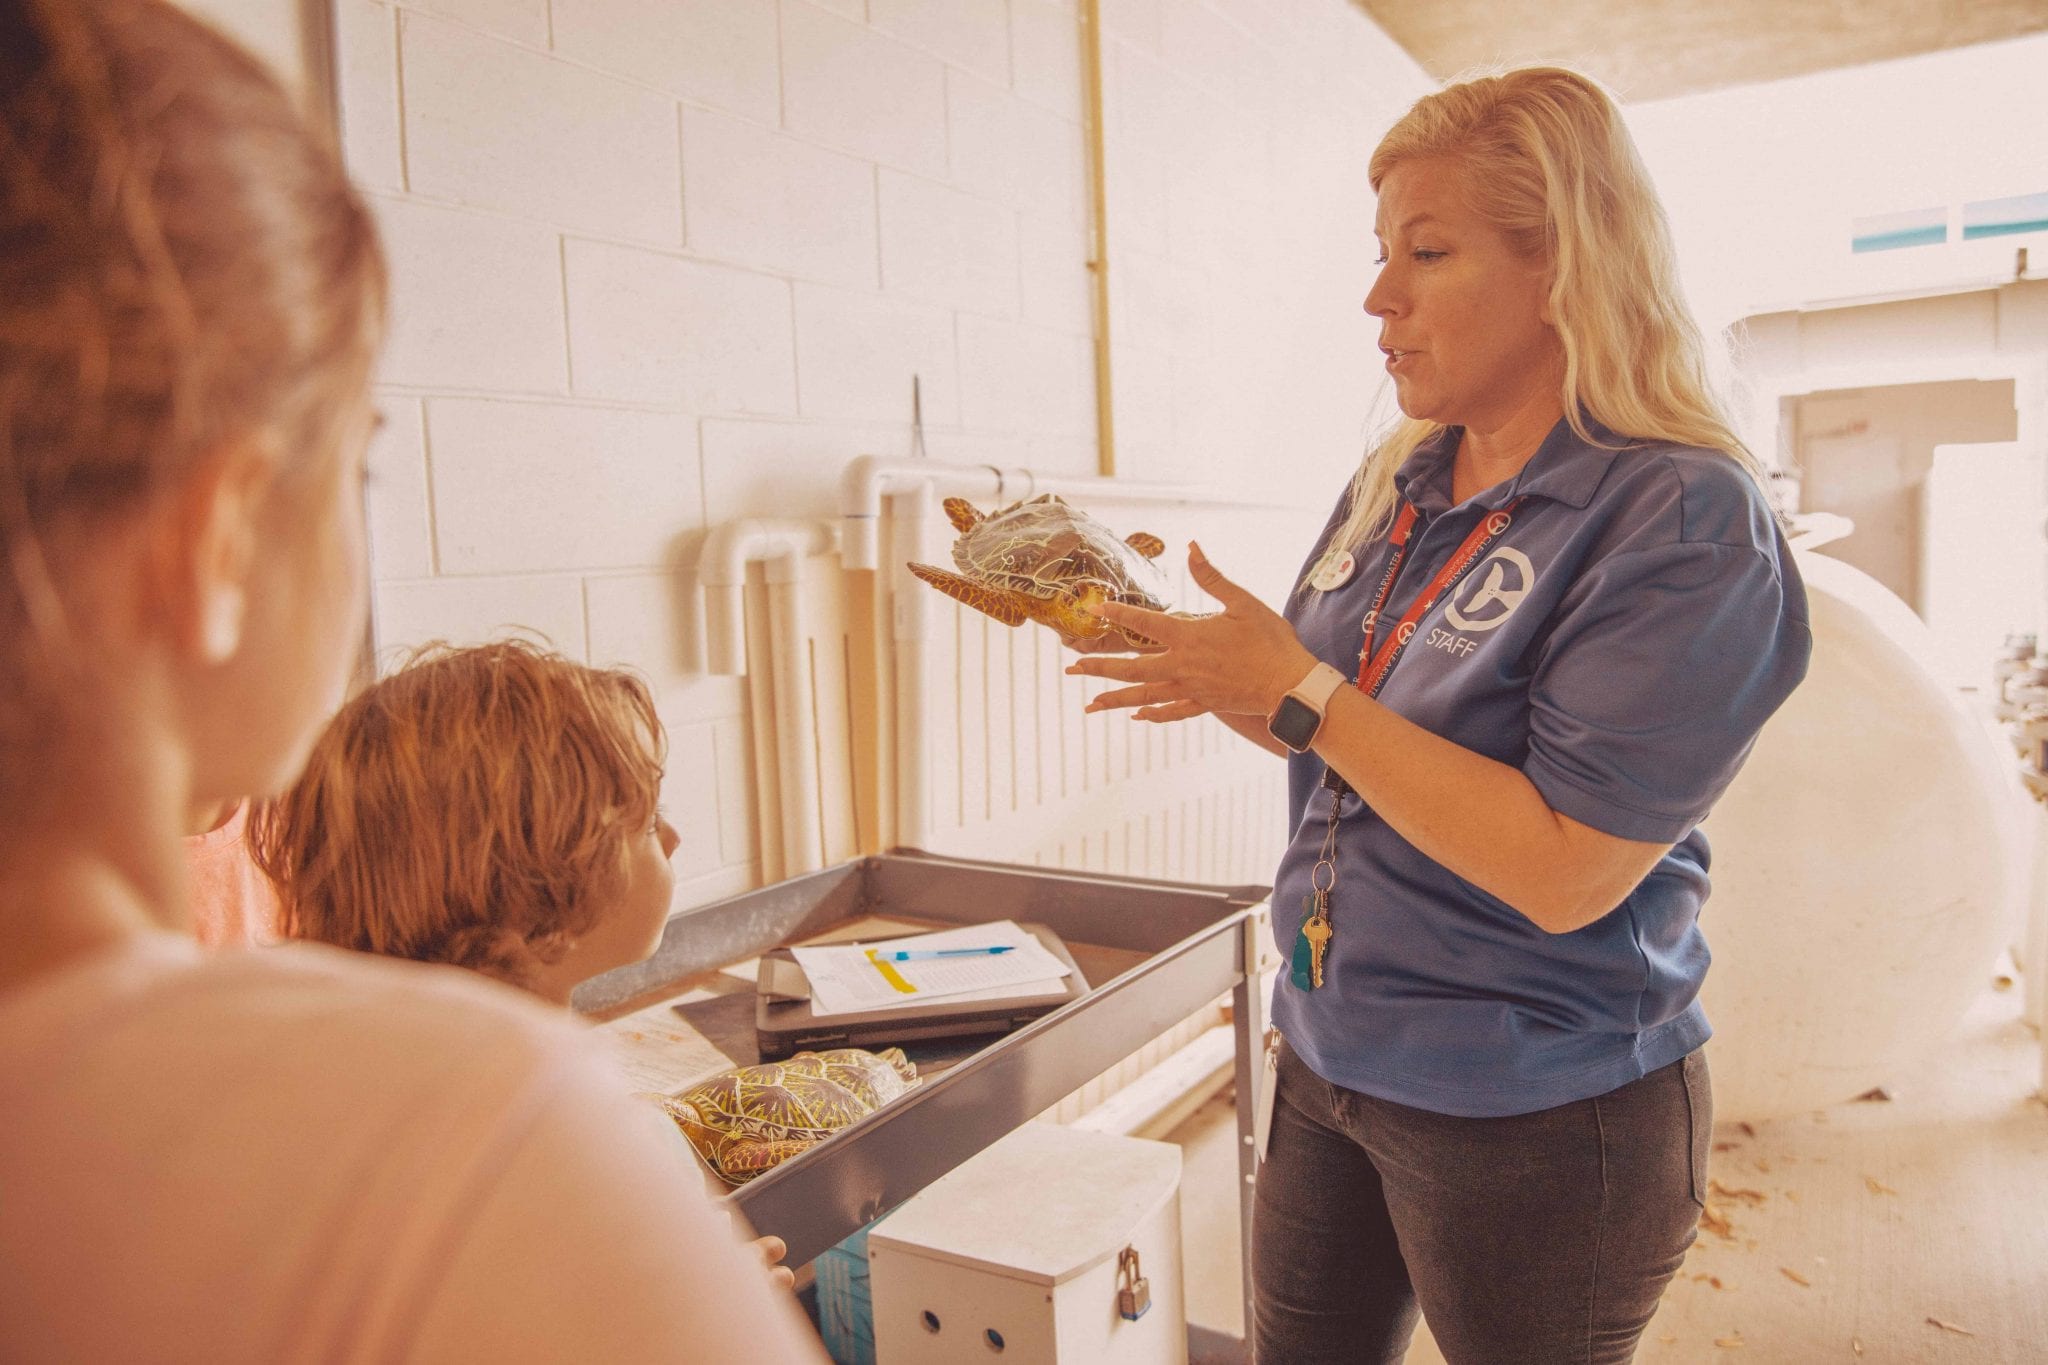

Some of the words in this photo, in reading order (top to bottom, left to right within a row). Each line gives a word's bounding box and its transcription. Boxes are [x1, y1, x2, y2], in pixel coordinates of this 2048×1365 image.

[1371, 551, 1401, 608] CLEARWATER
[1442, 536, 1491, 589] CLEARWATER
[1426, 627, 1478, 658] STAFF
[1368, 646, 1401, 697] CLEARWATE
